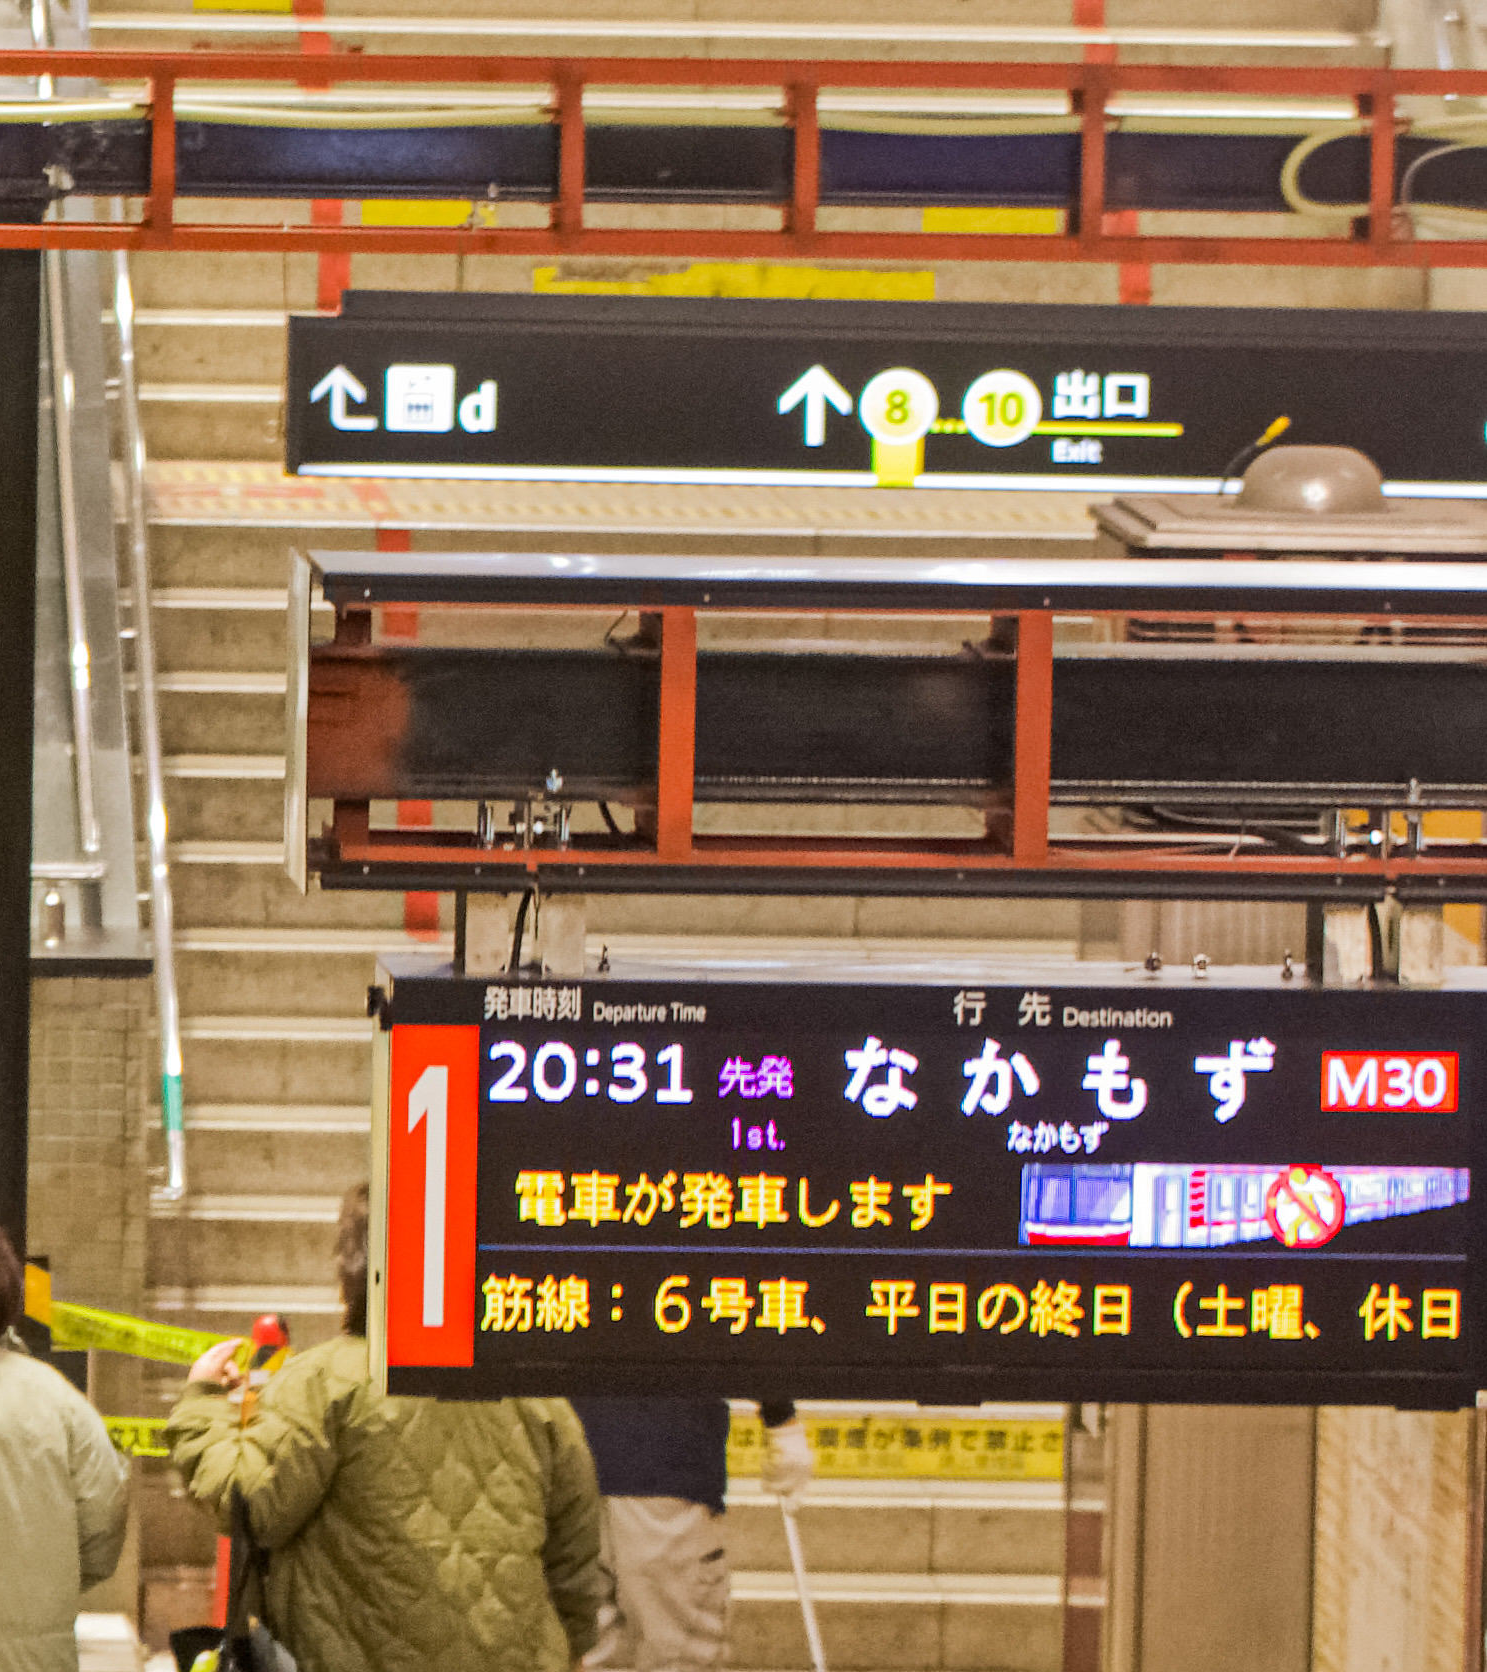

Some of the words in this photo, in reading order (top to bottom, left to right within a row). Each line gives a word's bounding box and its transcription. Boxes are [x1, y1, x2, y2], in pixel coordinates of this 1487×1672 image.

[458, 379, 498, 434] d
[885, 389, 910, 425] 8
[978, 391, 1025, 427] 10
[1052, 369, 1151, 419] 出口
[1051, 438, 1104, 464] Exit
[483, 986, 582, 1022] 発車時刻
[593, 1001, 666, 1027] Departure
[670, 1001, 707, 1023] Time
[1062, 1006, 1173, 1029] Destination
[487, 1040, 693, 1104] 20:31
[718, 1055, 795, 1100] 先発
[844, 1035, 1277, 1124] なかもず
[1327, 1058, 1448, 1108] M30
[730, 1117, 787, 1151] 1st.
[1006, 1120, 1110, 1155] なかもず
[407, 1064, 449, 1328] 1
[514, 1168, 953, 1232] 電車が発車します
